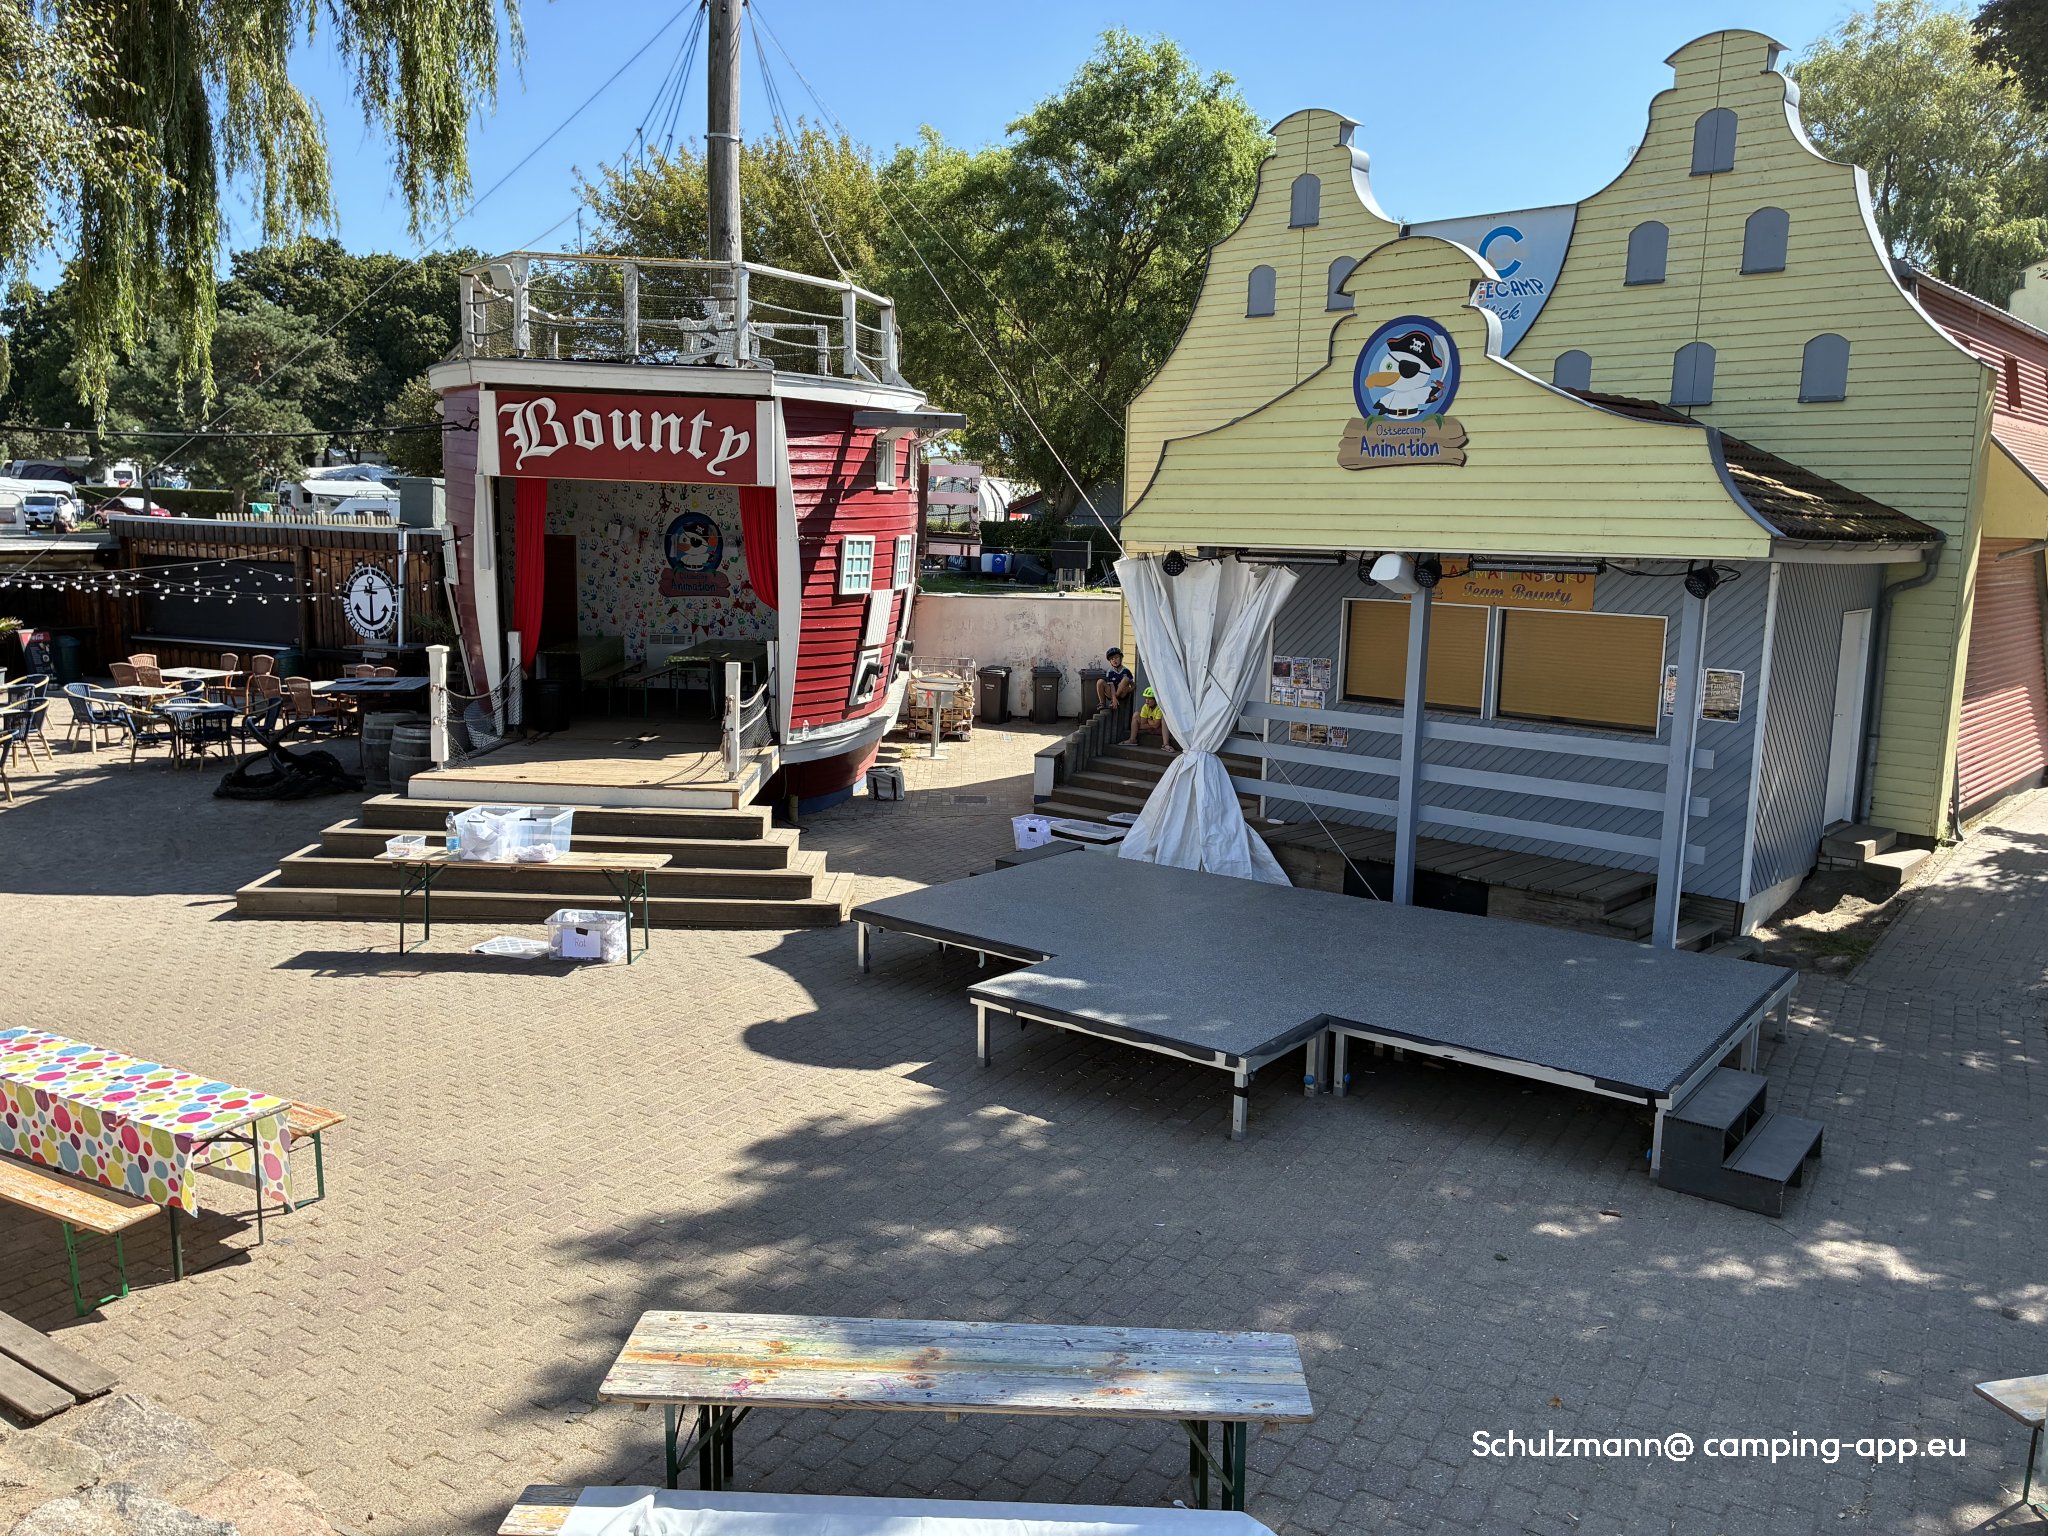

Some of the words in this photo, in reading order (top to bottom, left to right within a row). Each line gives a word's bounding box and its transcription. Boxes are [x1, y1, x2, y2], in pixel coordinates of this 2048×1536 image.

[498, 397, 750, 476] Bounty
[1376, 424, 1426, 438] Ostseecamp
[1360, 435, 1440, 458] Animation
[1462, 581, 1505, 598] Team
[1510, 583, 1573, 606] Bounty
[342, 597, 376, 640] ANKERBAR
